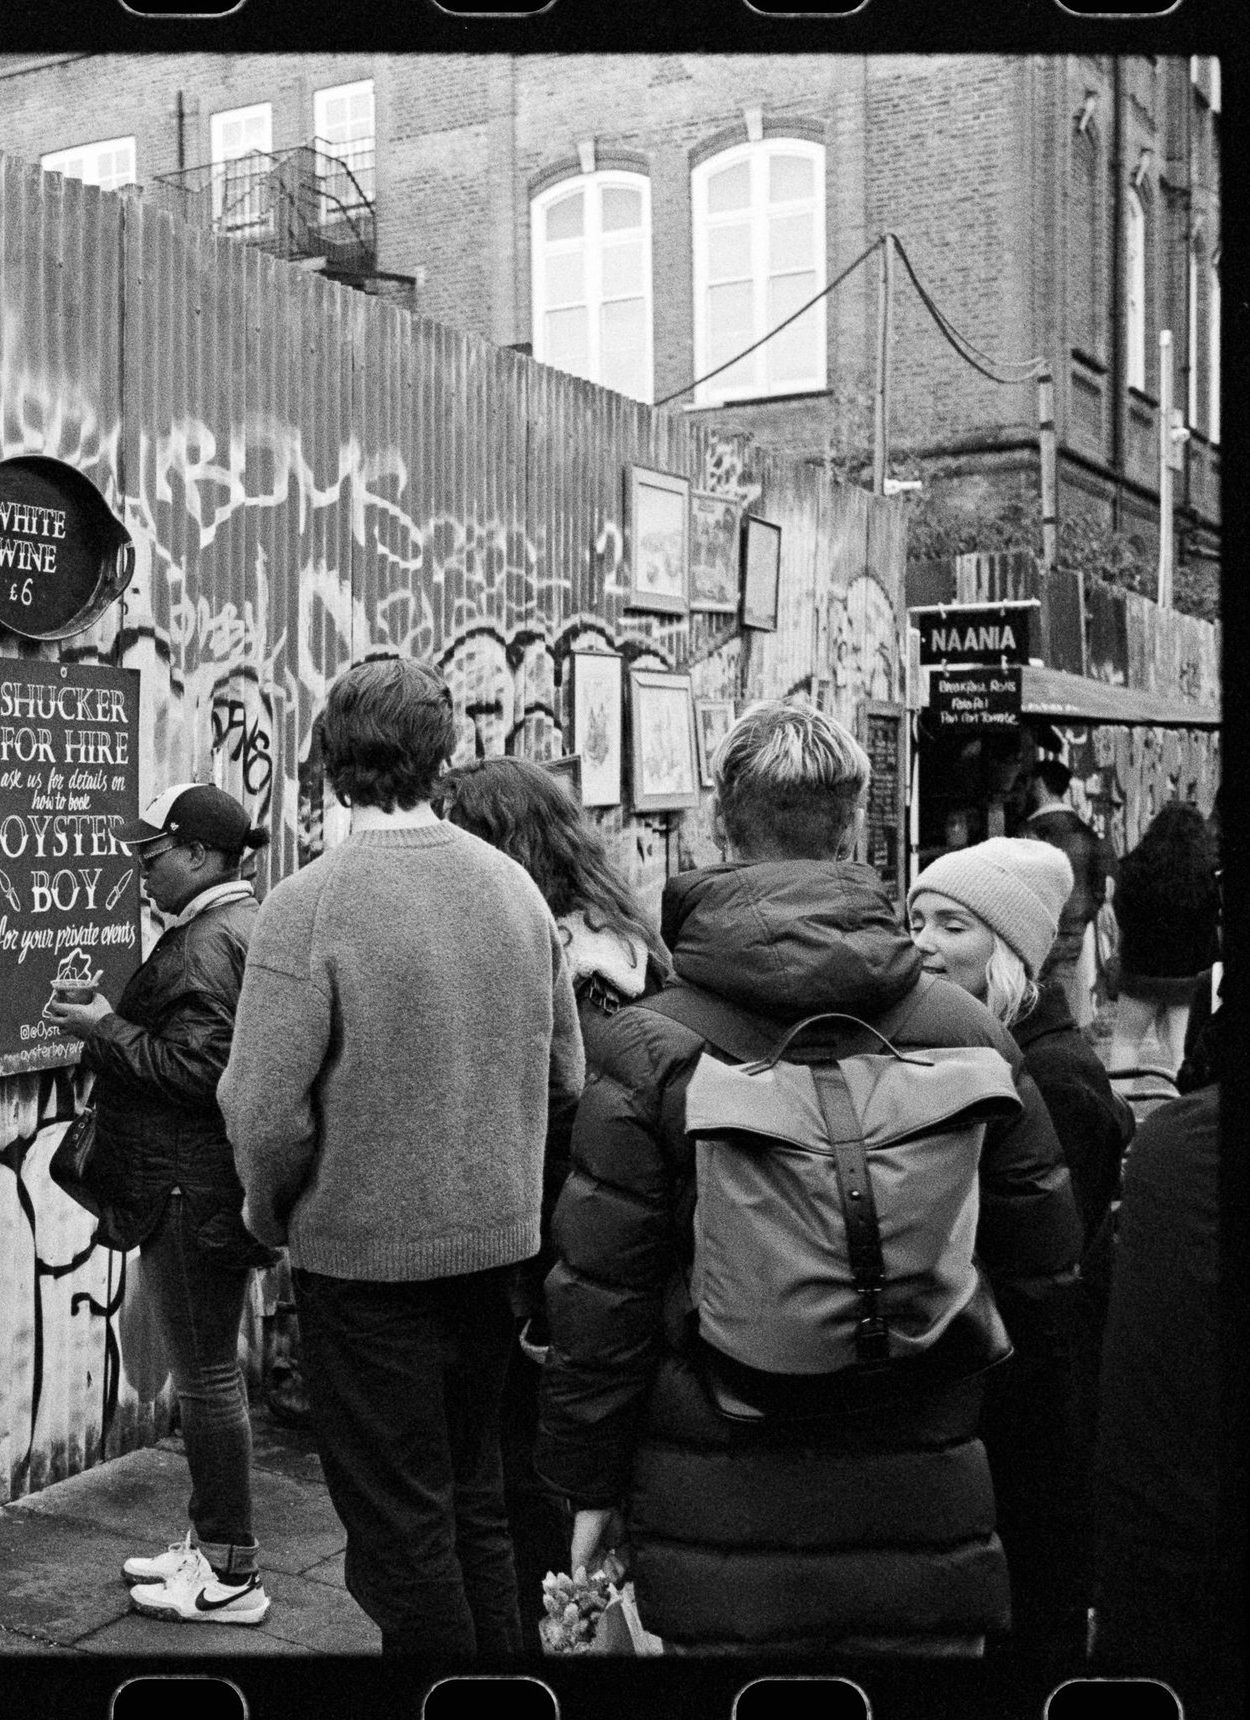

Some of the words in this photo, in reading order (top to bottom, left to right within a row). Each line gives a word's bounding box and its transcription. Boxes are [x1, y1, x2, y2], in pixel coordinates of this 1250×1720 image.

[931, 625, 1017, 652] NAANIA
[0, 681, 129, 724] SHUCKER
[0, 726, 56, 763] FOR
[64, 729, 129, 765] HIRE
[0, 769, 23, 790] ask
[27, 772, 43, 789] us
[47, 767, 65, 794] for
[68, 768, 108, 792] details
[111, 775, 126, 791] on
[31, 789, 54, 810] how
[55, 791, 67, 810] to
[68, 791, 92, 811] book
[0, 814, 133, 859] OYSTER
[30, 868, 103, 913] BOY
[18, 928, 53, 964] your
[54, 922, 100, 956] private
[101, 920, 136, 949] events
